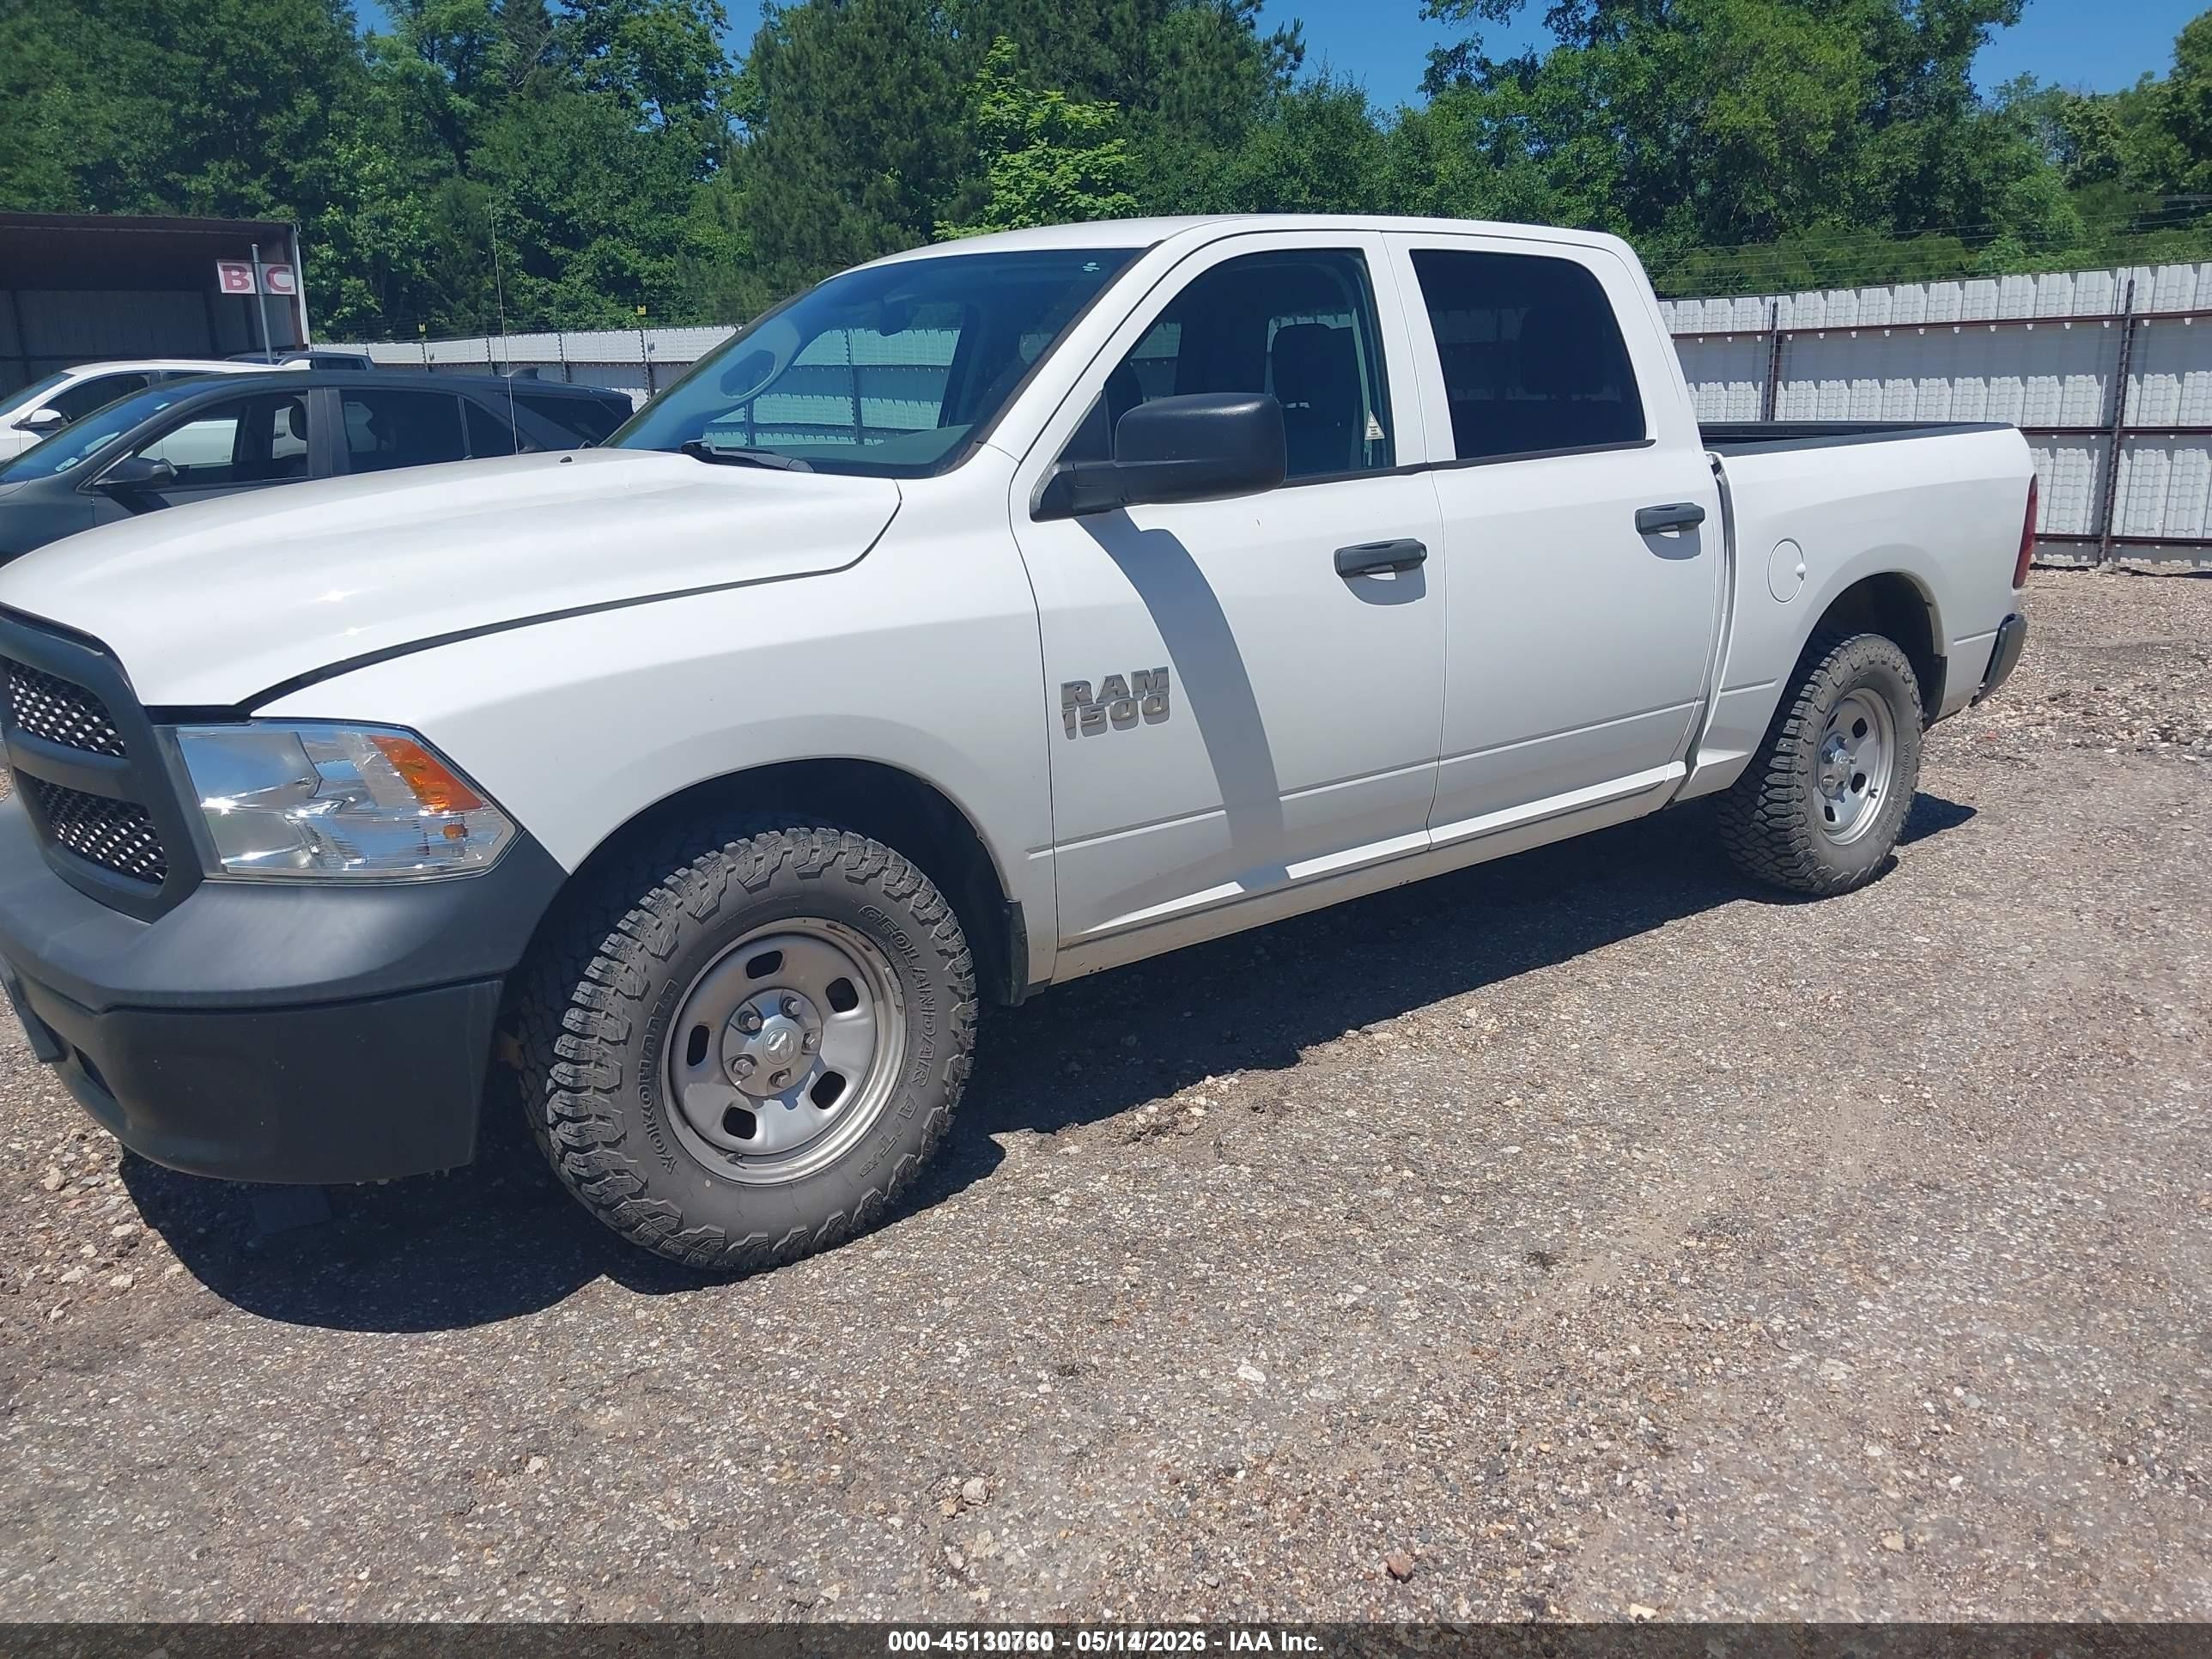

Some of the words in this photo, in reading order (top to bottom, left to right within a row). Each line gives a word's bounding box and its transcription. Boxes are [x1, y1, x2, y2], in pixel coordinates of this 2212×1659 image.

[222, 264, 250, 290] B
[266, 265, 291, 292] C
[1060, 666, 1170, 709] RAM
[1062, 693, 1170, 740] 1500
[859, 904, 937, 1087] GEOLANDAR
